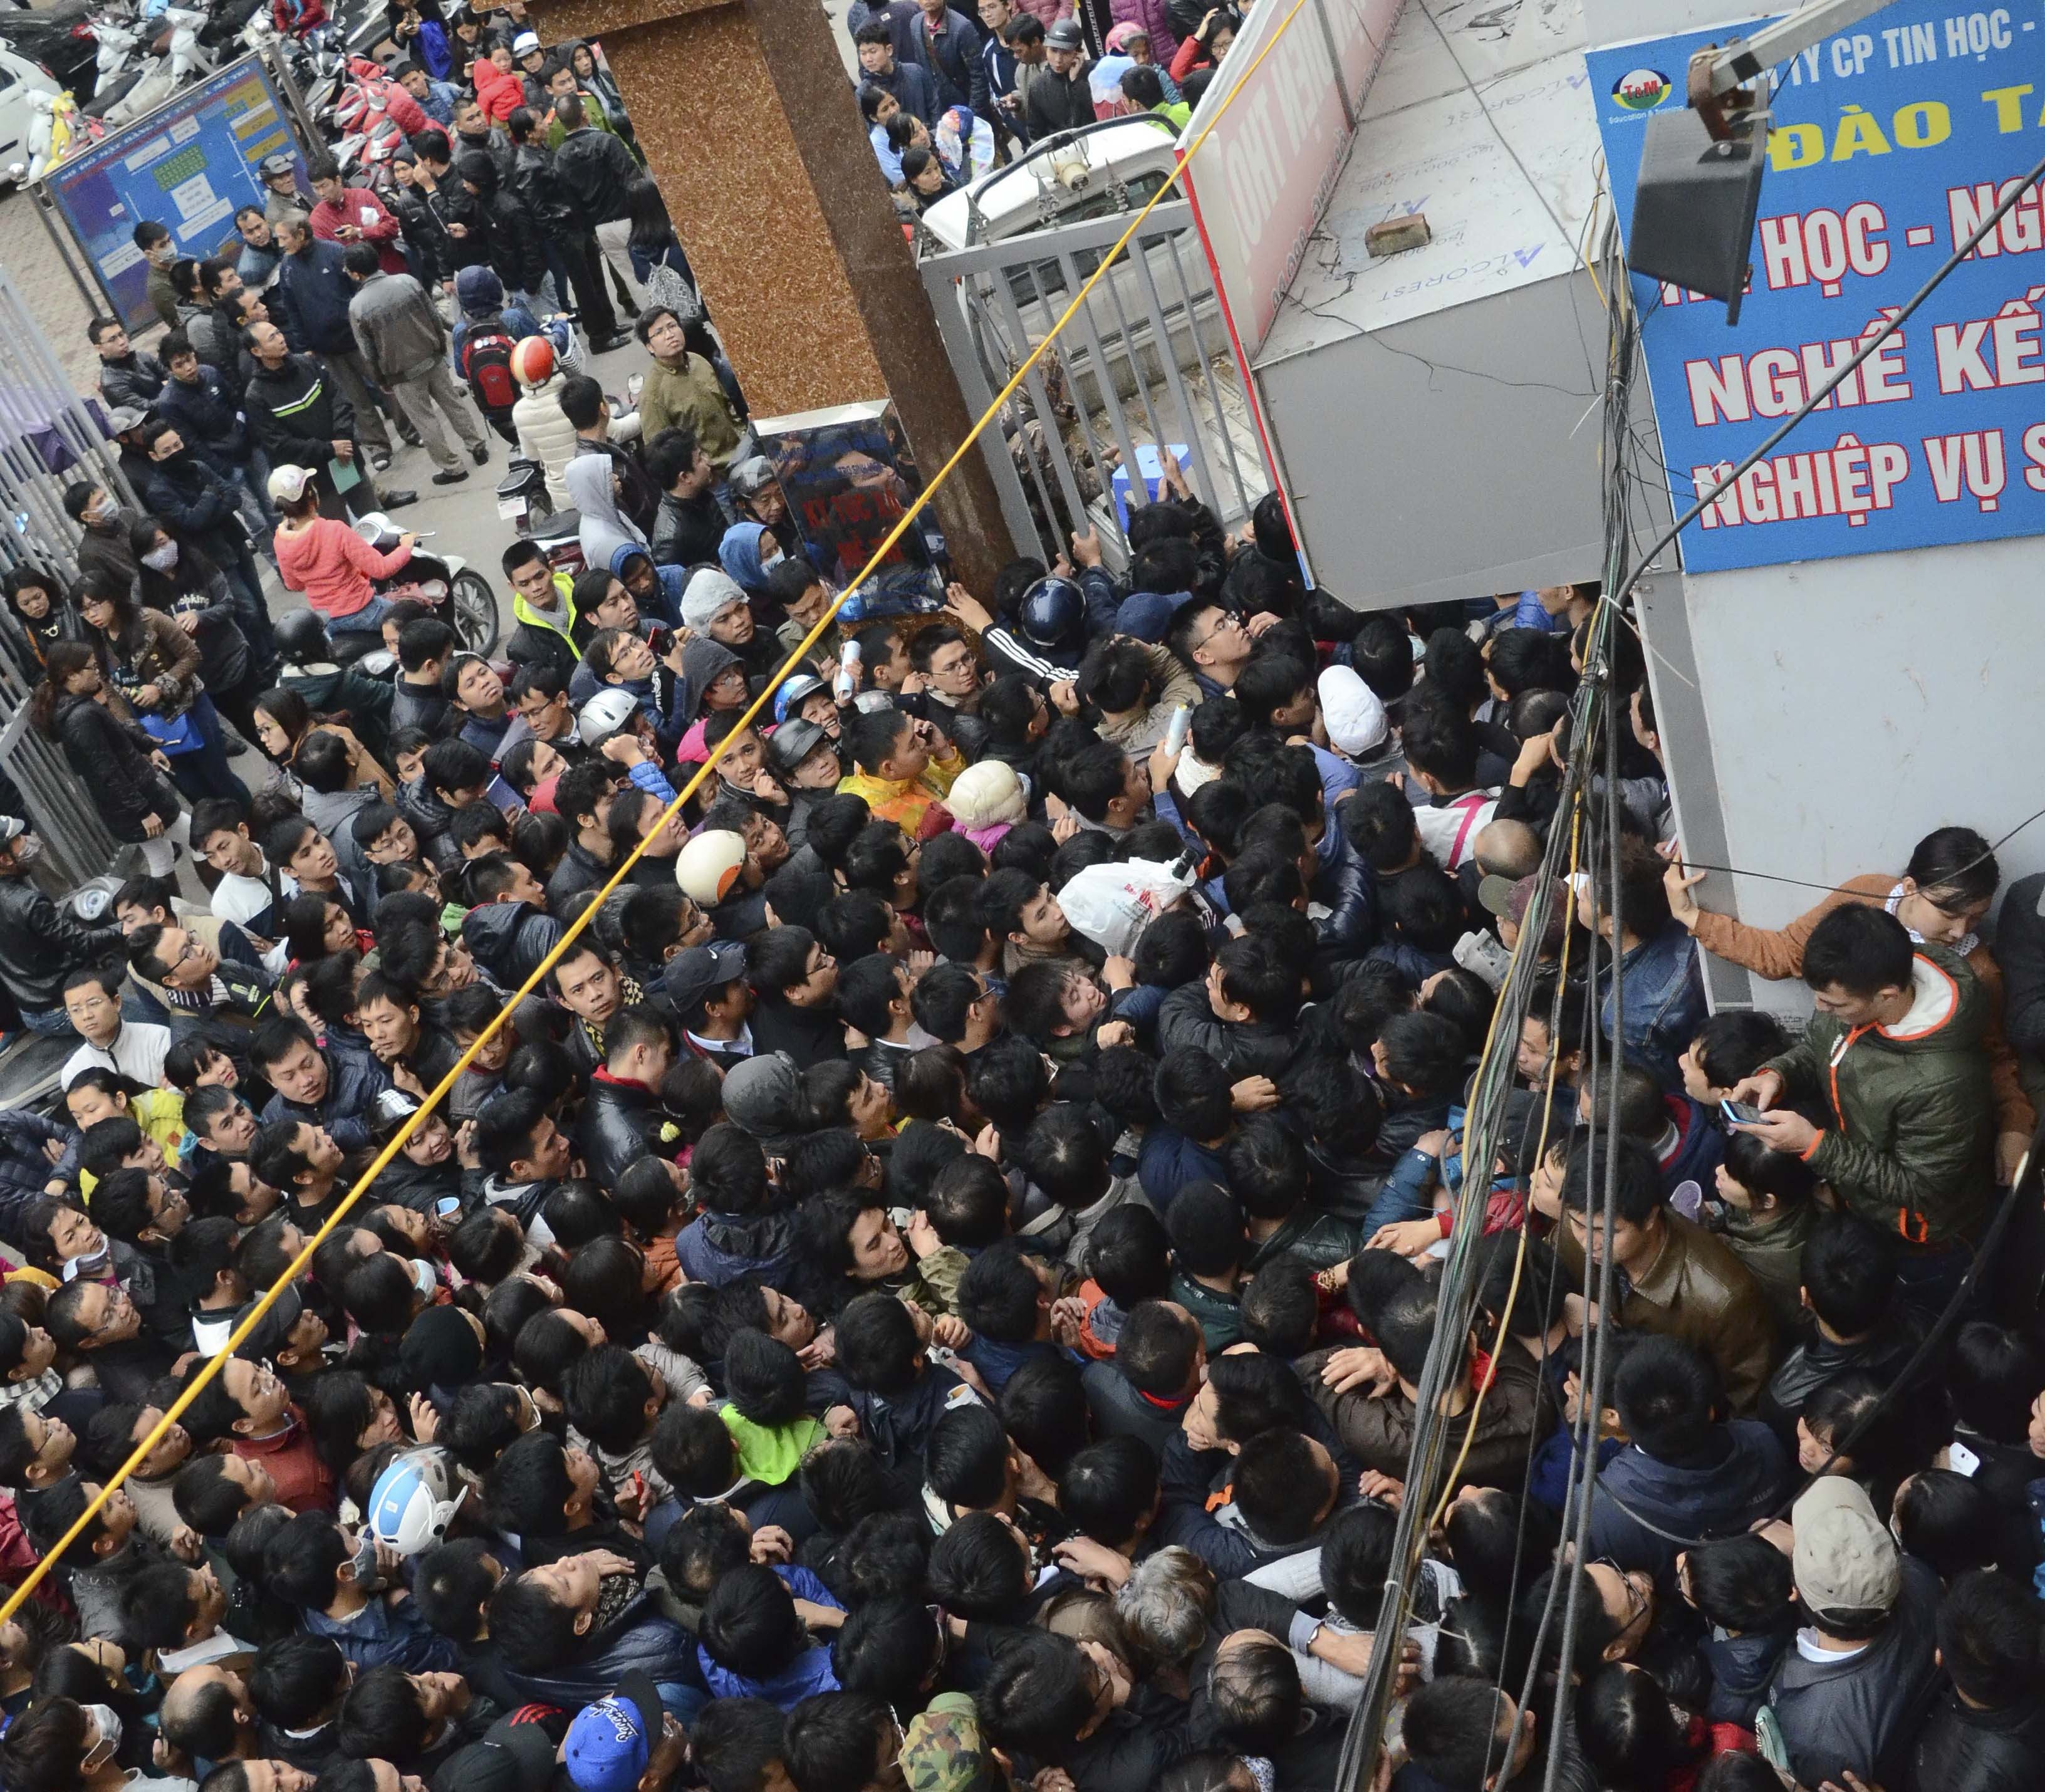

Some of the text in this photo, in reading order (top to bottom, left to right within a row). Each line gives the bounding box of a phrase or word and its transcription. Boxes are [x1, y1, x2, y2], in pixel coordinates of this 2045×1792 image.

[1624, 80, 1660, 100] T&M
[1831, 34, 1873, 78] CP
[1881, 22, 1937, 68] TIN
[1944, 8, 2012, 63] HỌC
[1765, 83, 2045, 172] ĐÀO T
[1758, 201, 1890, 298] HỌC
[1947, 177, 2045, 261] NG
[1684, 284, 2045, 427] NGHỀ KẾ
[1692, 432, 1910, 530] NGHIỆP
[1922, 428, 2007, 513] VỤ
